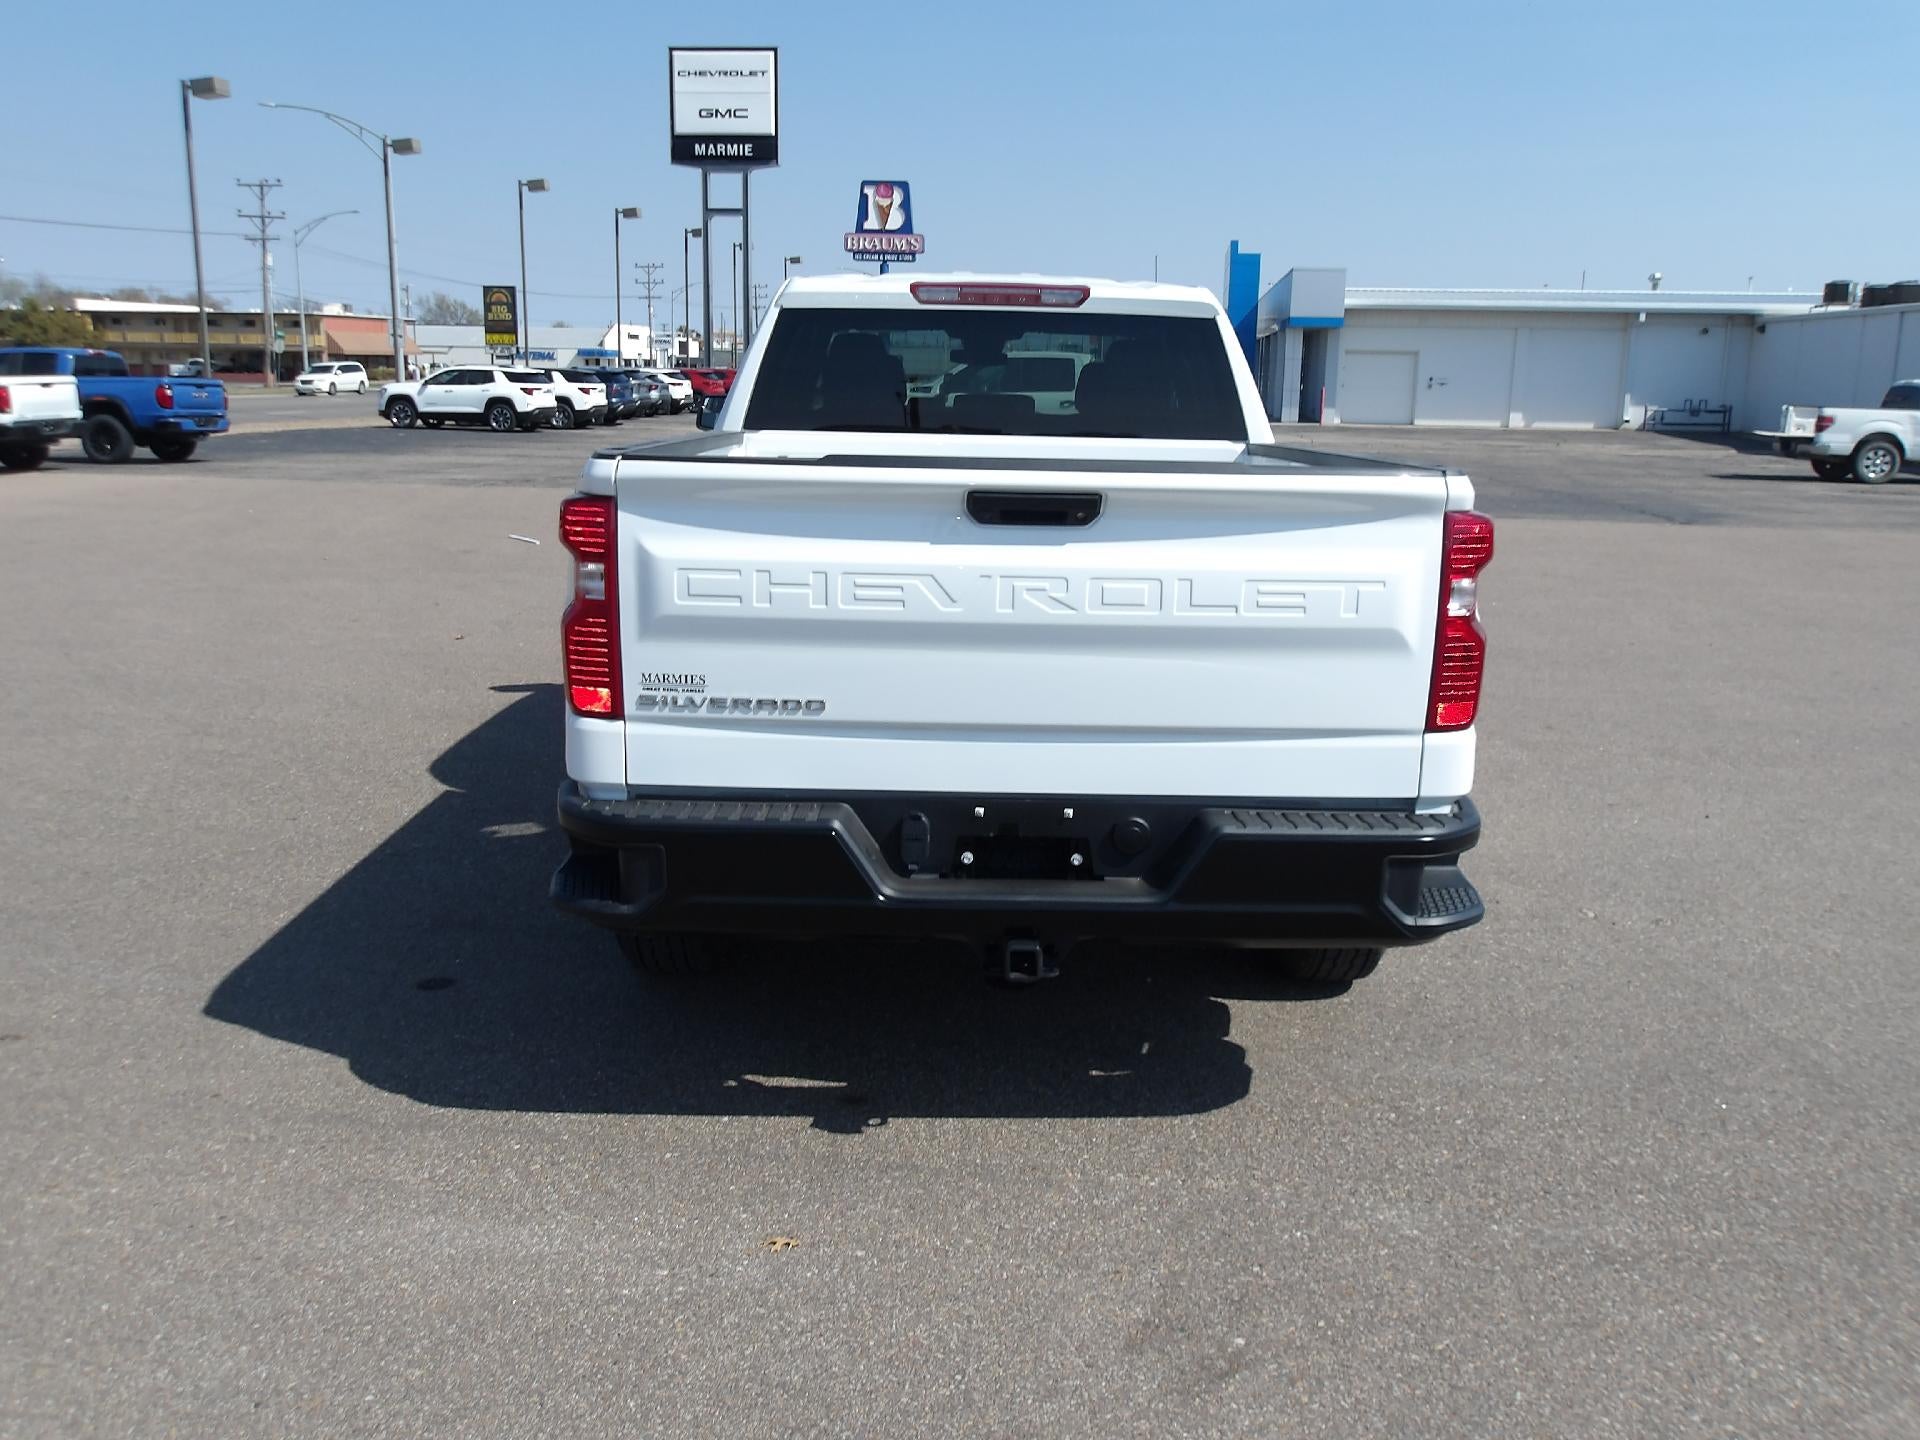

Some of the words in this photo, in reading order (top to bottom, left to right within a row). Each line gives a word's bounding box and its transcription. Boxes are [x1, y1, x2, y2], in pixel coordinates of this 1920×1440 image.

[677, 69, 768, 77] CHEVROLET
[698, 108, 749, 119] GMC
[694, 143, 753, 156] MARMIE
[862, 184, 906, 231] B
[846, 236, 920, 252] BRAUM'S
[673, 567, 1386, 618] CHEVROLET
[641, 672, 706, 686] MARMIES
[635, 694, 826, 714] SILVERADO
